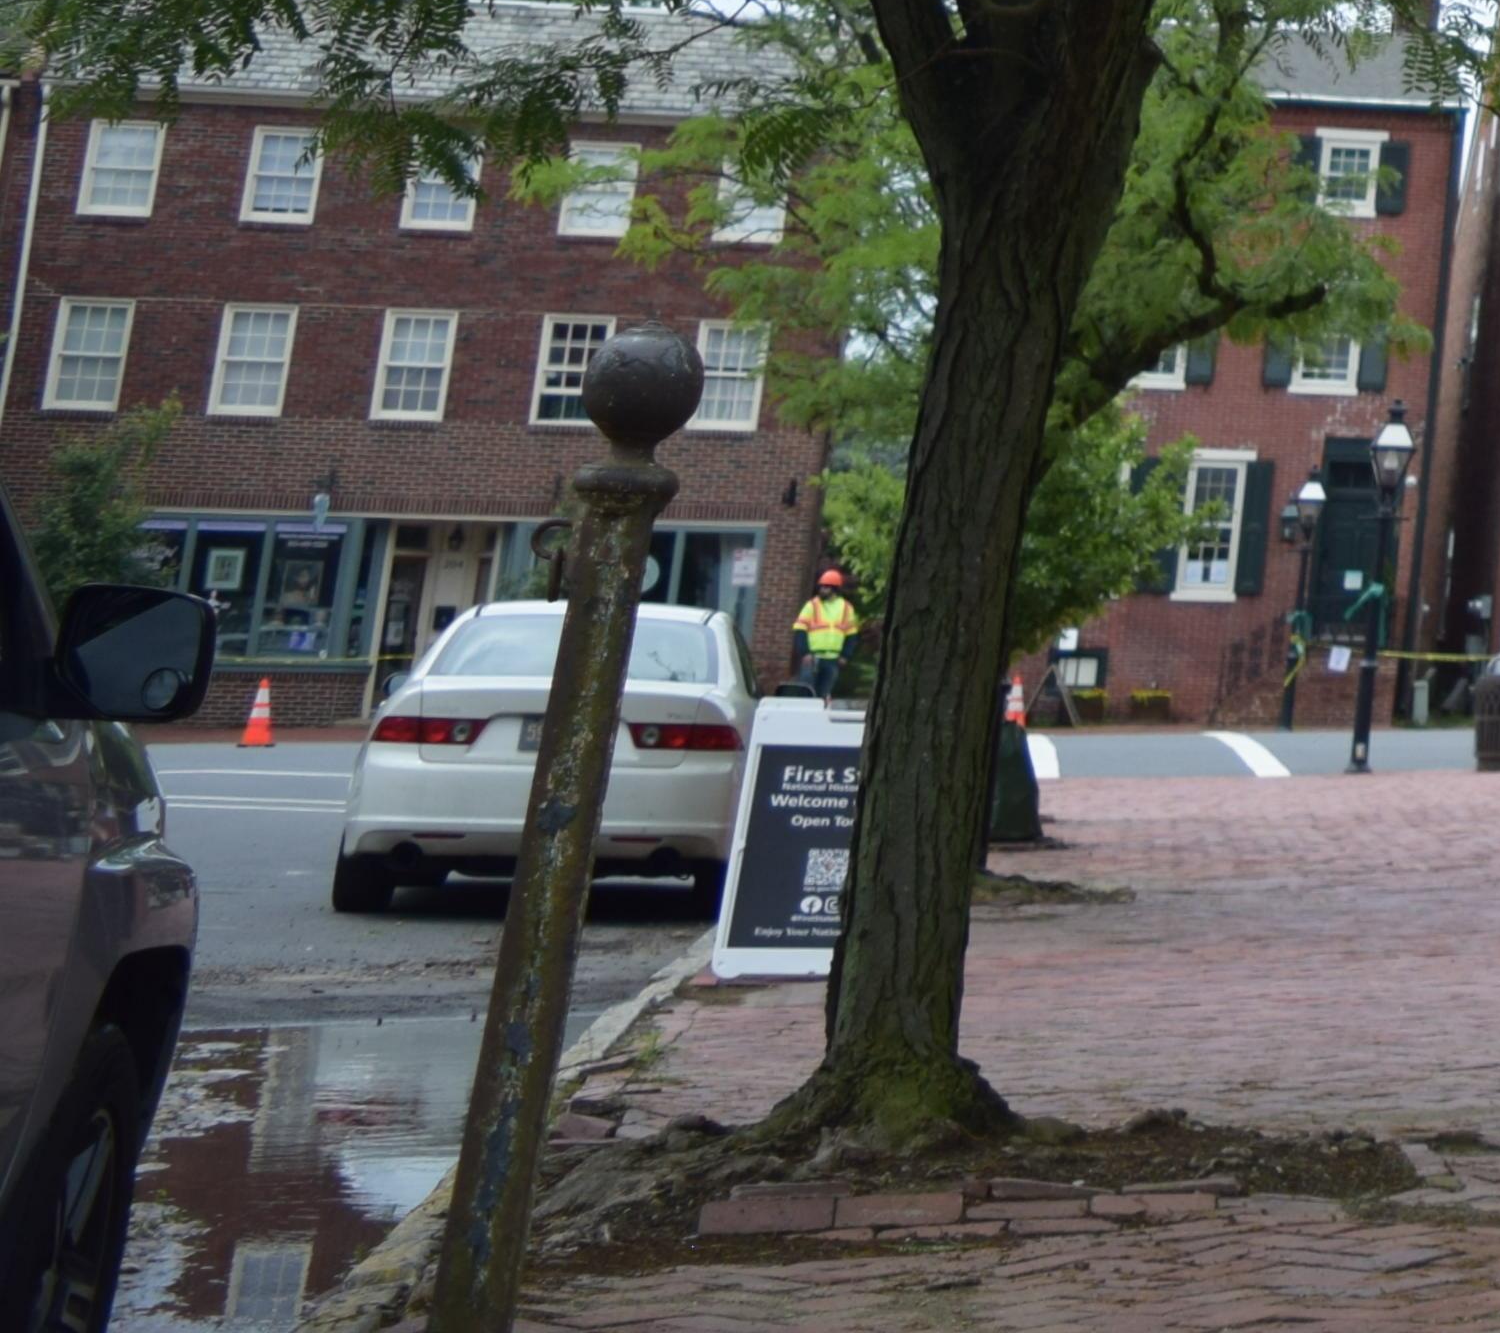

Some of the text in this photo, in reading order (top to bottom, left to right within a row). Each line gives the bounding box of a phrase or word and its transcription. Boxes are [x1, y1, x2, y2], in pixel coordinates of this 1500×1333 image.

[784, 765, 835, 783] First
[782, 783, 826, 792] National
[770, 794, 849, 808] Welcome
[791, 815, 831, 829] Open
